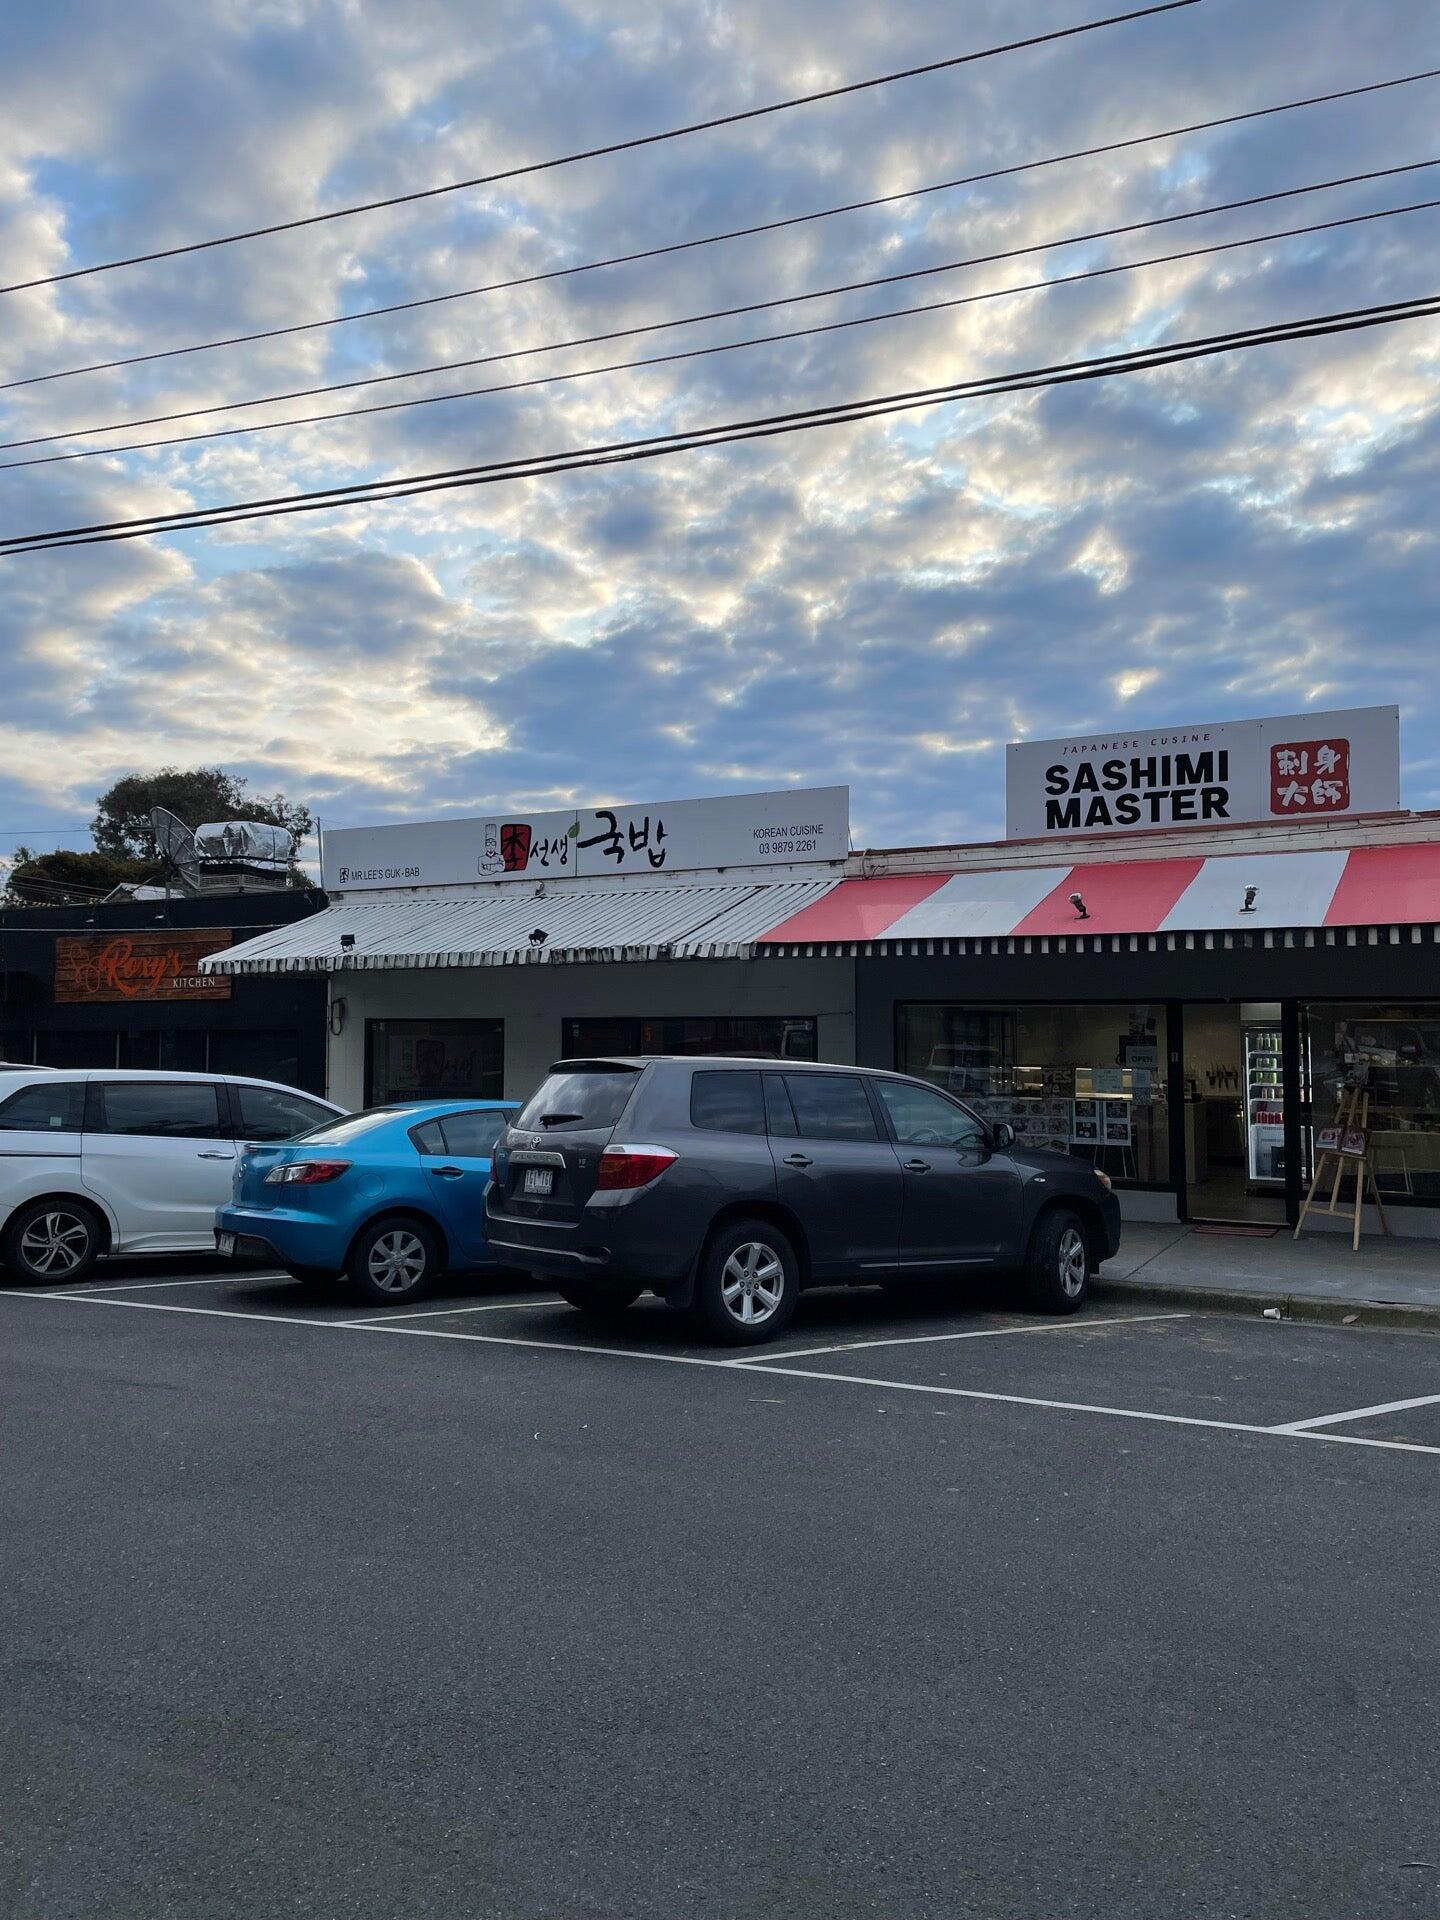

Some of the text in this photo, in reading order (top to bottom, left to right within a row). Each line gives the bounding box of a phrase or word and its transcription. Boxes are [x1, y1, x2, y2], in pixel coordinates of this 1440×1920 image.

[1063, 733, 1211, 755] JAPANESE CUSINE
[1044, 750, 1229, 796] SASHIMI
[1044, 786, 1231, 830] MASTER
[576, 811, 669, 868] 국밥
[753, 824, 824, 839] KOREAN CUISINE
[759, 839, 816, 854] 03 9879 2261
[99, 939, 184, 997] Roxy's
[172, 976, 216, 988] KITCHEN
[1131, 1055, 1153, 1063] OPEN
